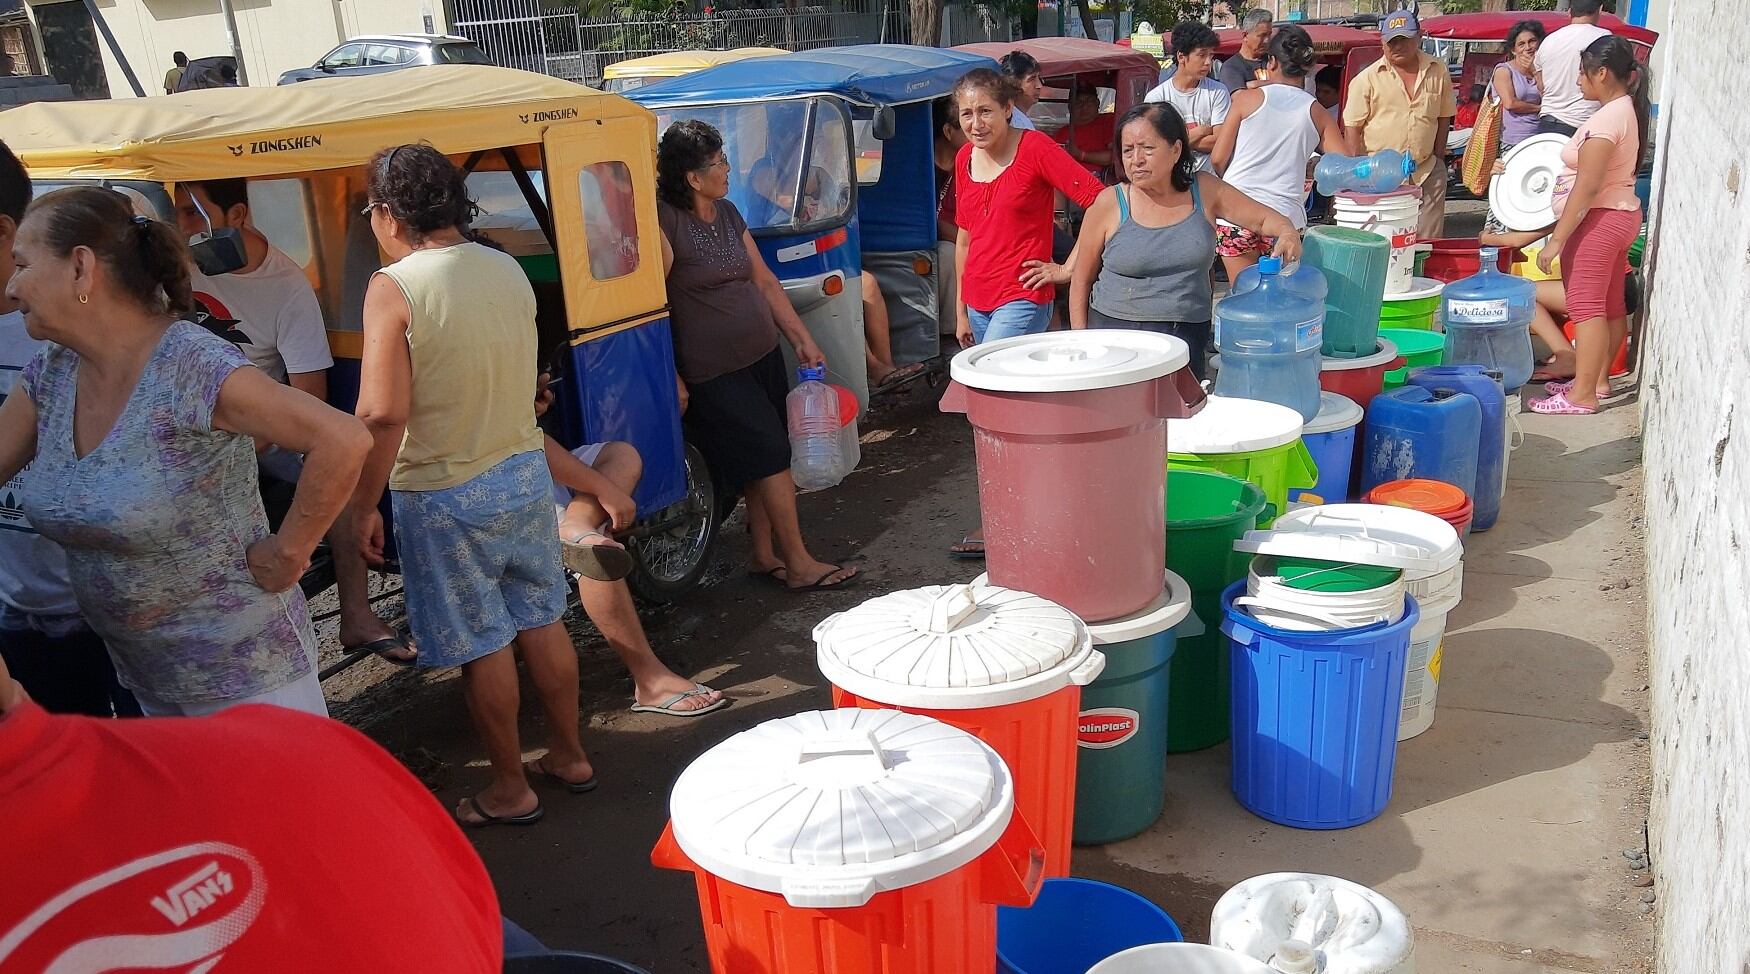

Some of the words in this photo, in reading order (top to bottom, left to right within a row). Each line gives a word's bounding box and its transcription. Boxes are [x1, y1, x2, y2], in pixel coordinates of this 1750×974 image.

[1389, 16, 1406, 29] CAT
[533, 107, 579, 123] ZONGSHEN
[250, 134, 322, 154] ZONGSHEN
[1459, 307, 1503, 317] Deliciosa
[1080, 720, 1131, 733] olinPlast
[150, 861, 234, 927] VANS
